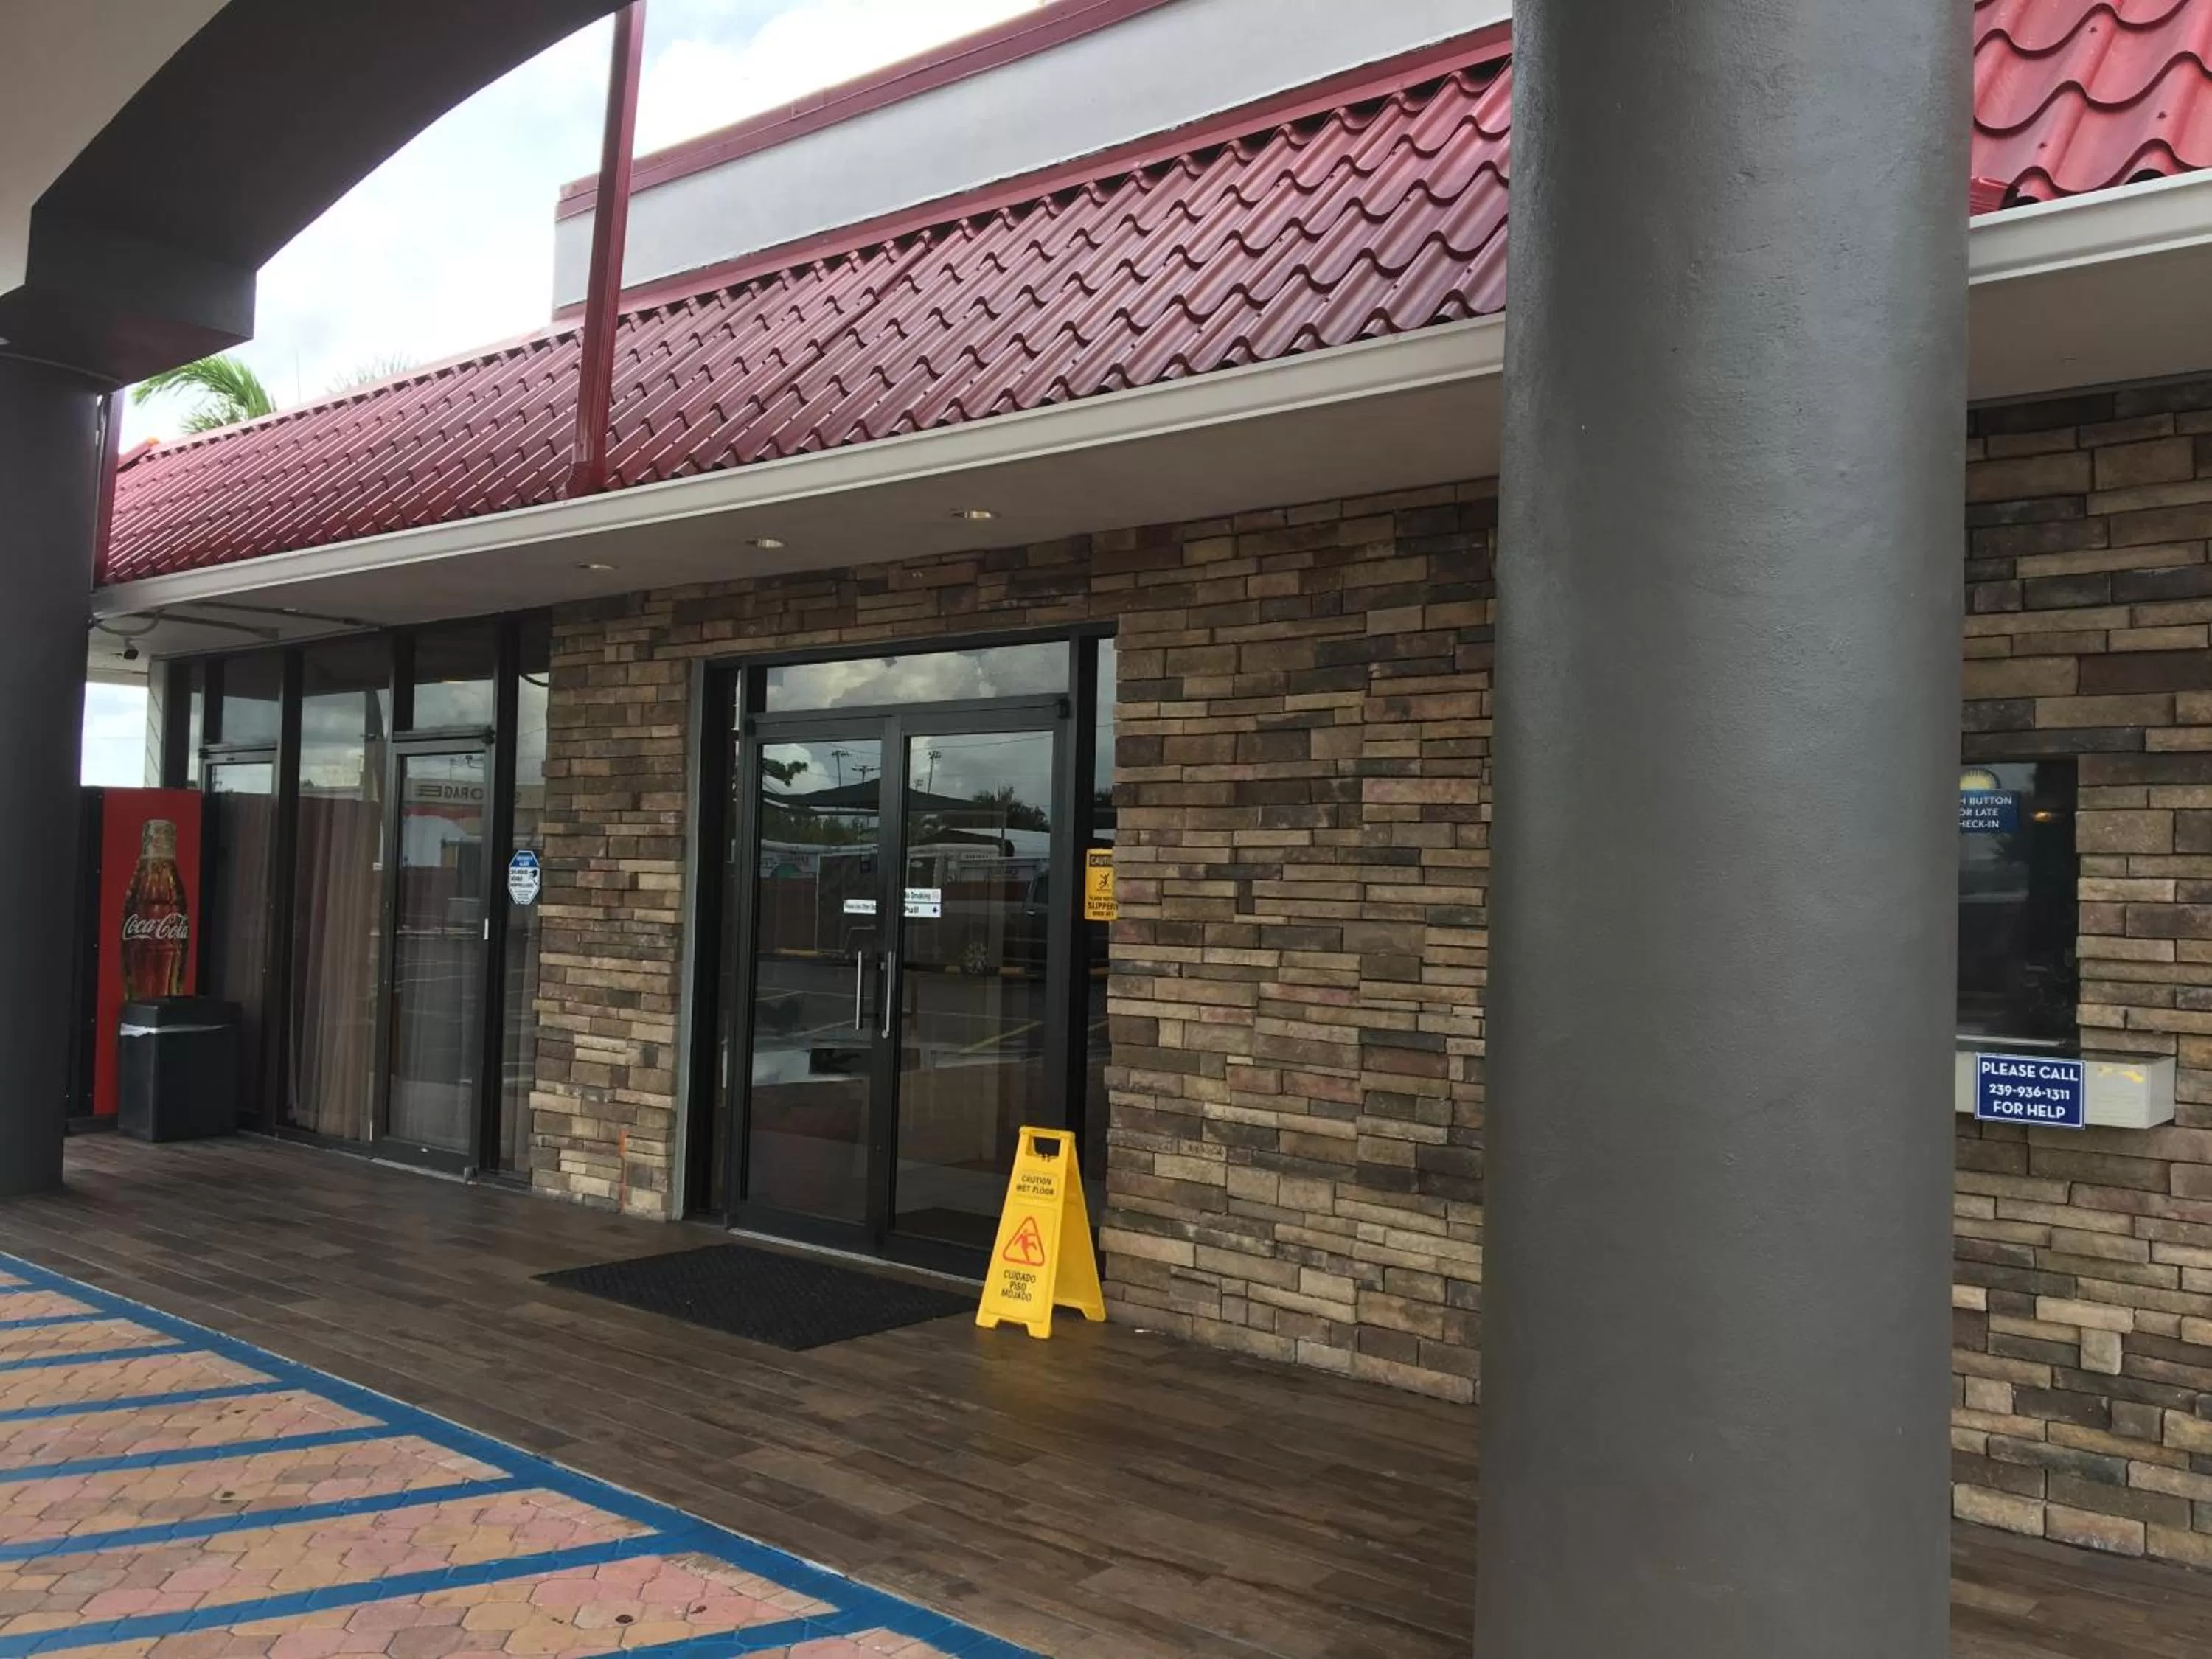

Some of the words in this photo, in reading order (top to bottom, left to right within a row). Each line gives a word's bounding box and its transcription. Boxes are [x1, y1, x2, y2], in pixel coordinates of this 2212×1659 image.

[1969, 796, 2012, 805] BUTTON
[1959, 807, 1972, 816] OR
[1975, 807, 1999, 816] LATE
[1958, 819, 1999, 828] HECK-IN
[122, 913, 189, 940] Coca-Cola
[1981, 1061, 2036, 1077] PLEASE
[2039, 1065, 2079, 1082] CALL
[1989, 1083, 2070, 1101] 239-936-1311
[1993, 1099, 2023, 1116] FOR
[2027, 1103, 2065, 1119] HELP
[1021, 1175, 1052, 1186] CAUTION
[1016, 1184, 1031, 1193] WET
[1032, 1186, 1054, 1195] FLOOR
[1004, 1269, 1037, 1284] CUIDADO
[1009, 1281, 1027, 1291] PISO
[1001, 1288, 1032, 1302] MOJADO
